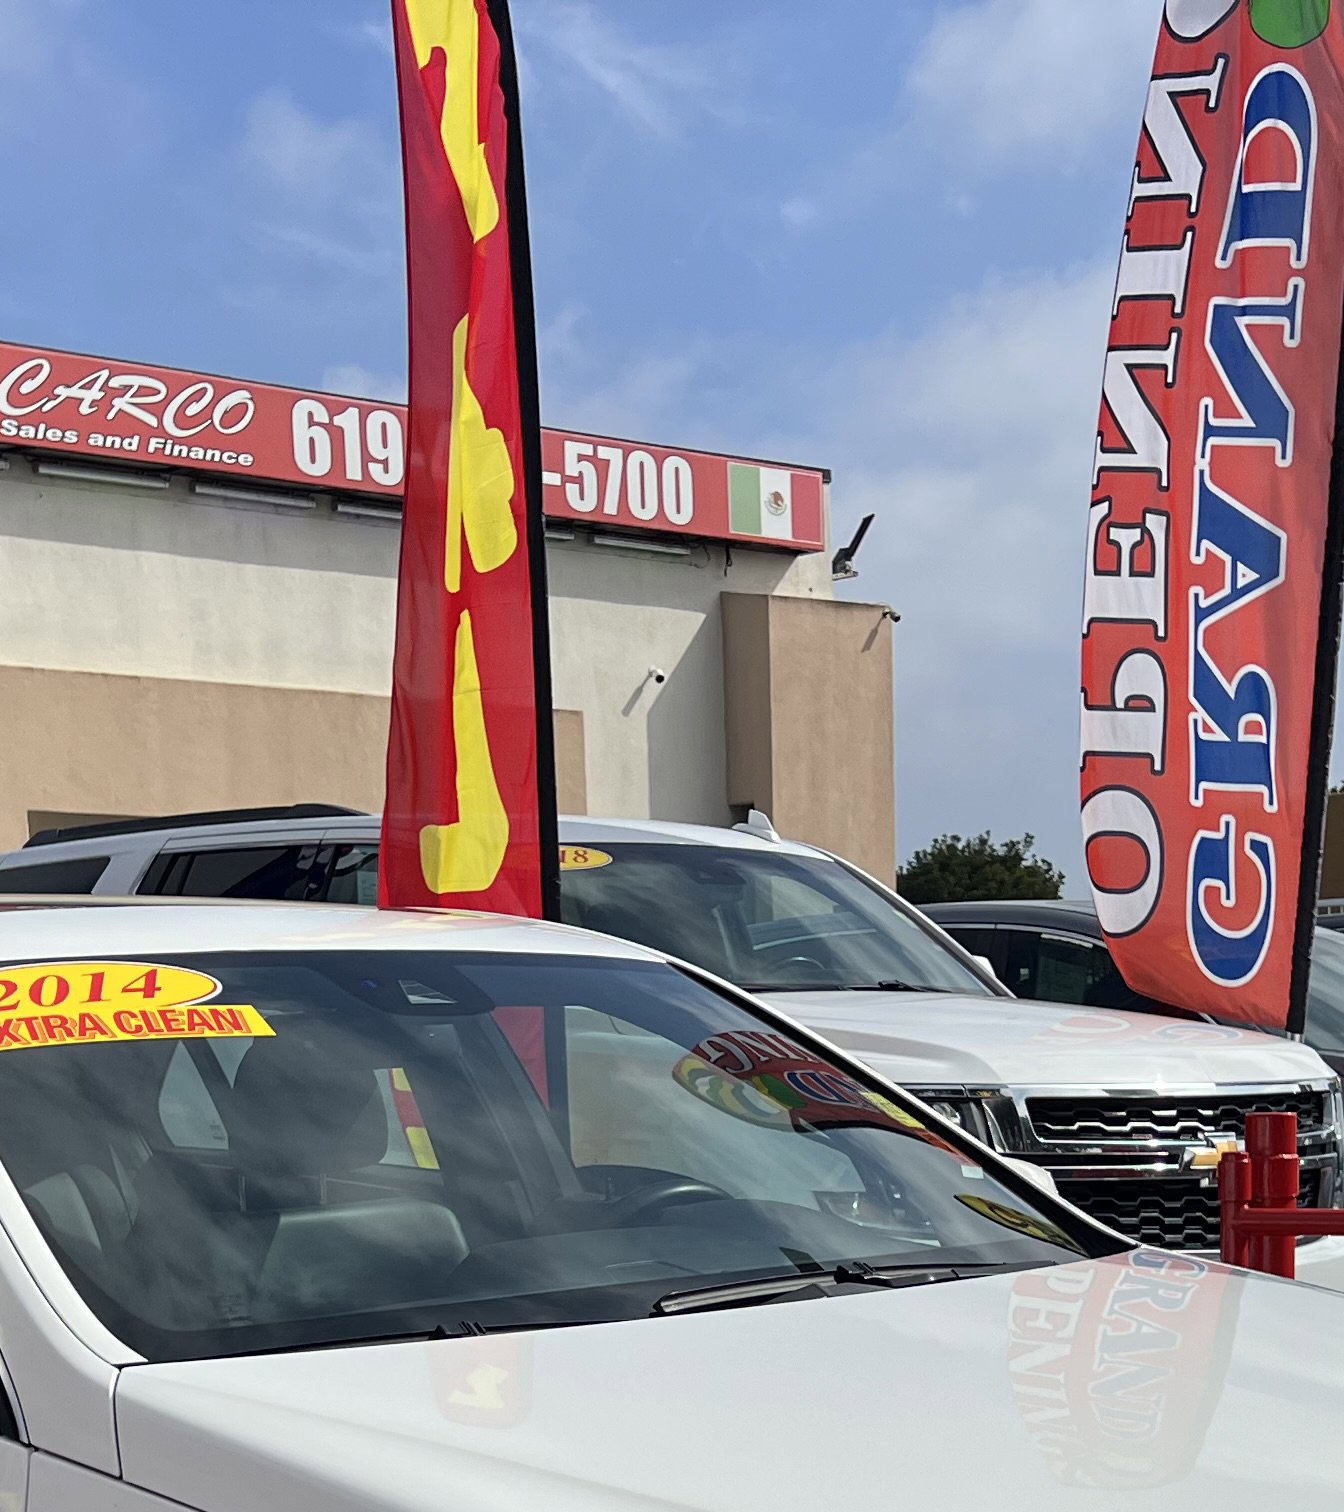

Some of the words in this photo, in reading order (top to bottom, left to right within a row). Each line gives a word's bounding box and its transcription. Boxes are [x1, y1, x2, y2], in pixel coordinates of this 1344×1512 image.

[0, 418, 79, 445] Sales
[87, 433, 140, 453] and
[147, 435, 255, 468] Finance
[113, 1008, 250, 1037] CLEAN
